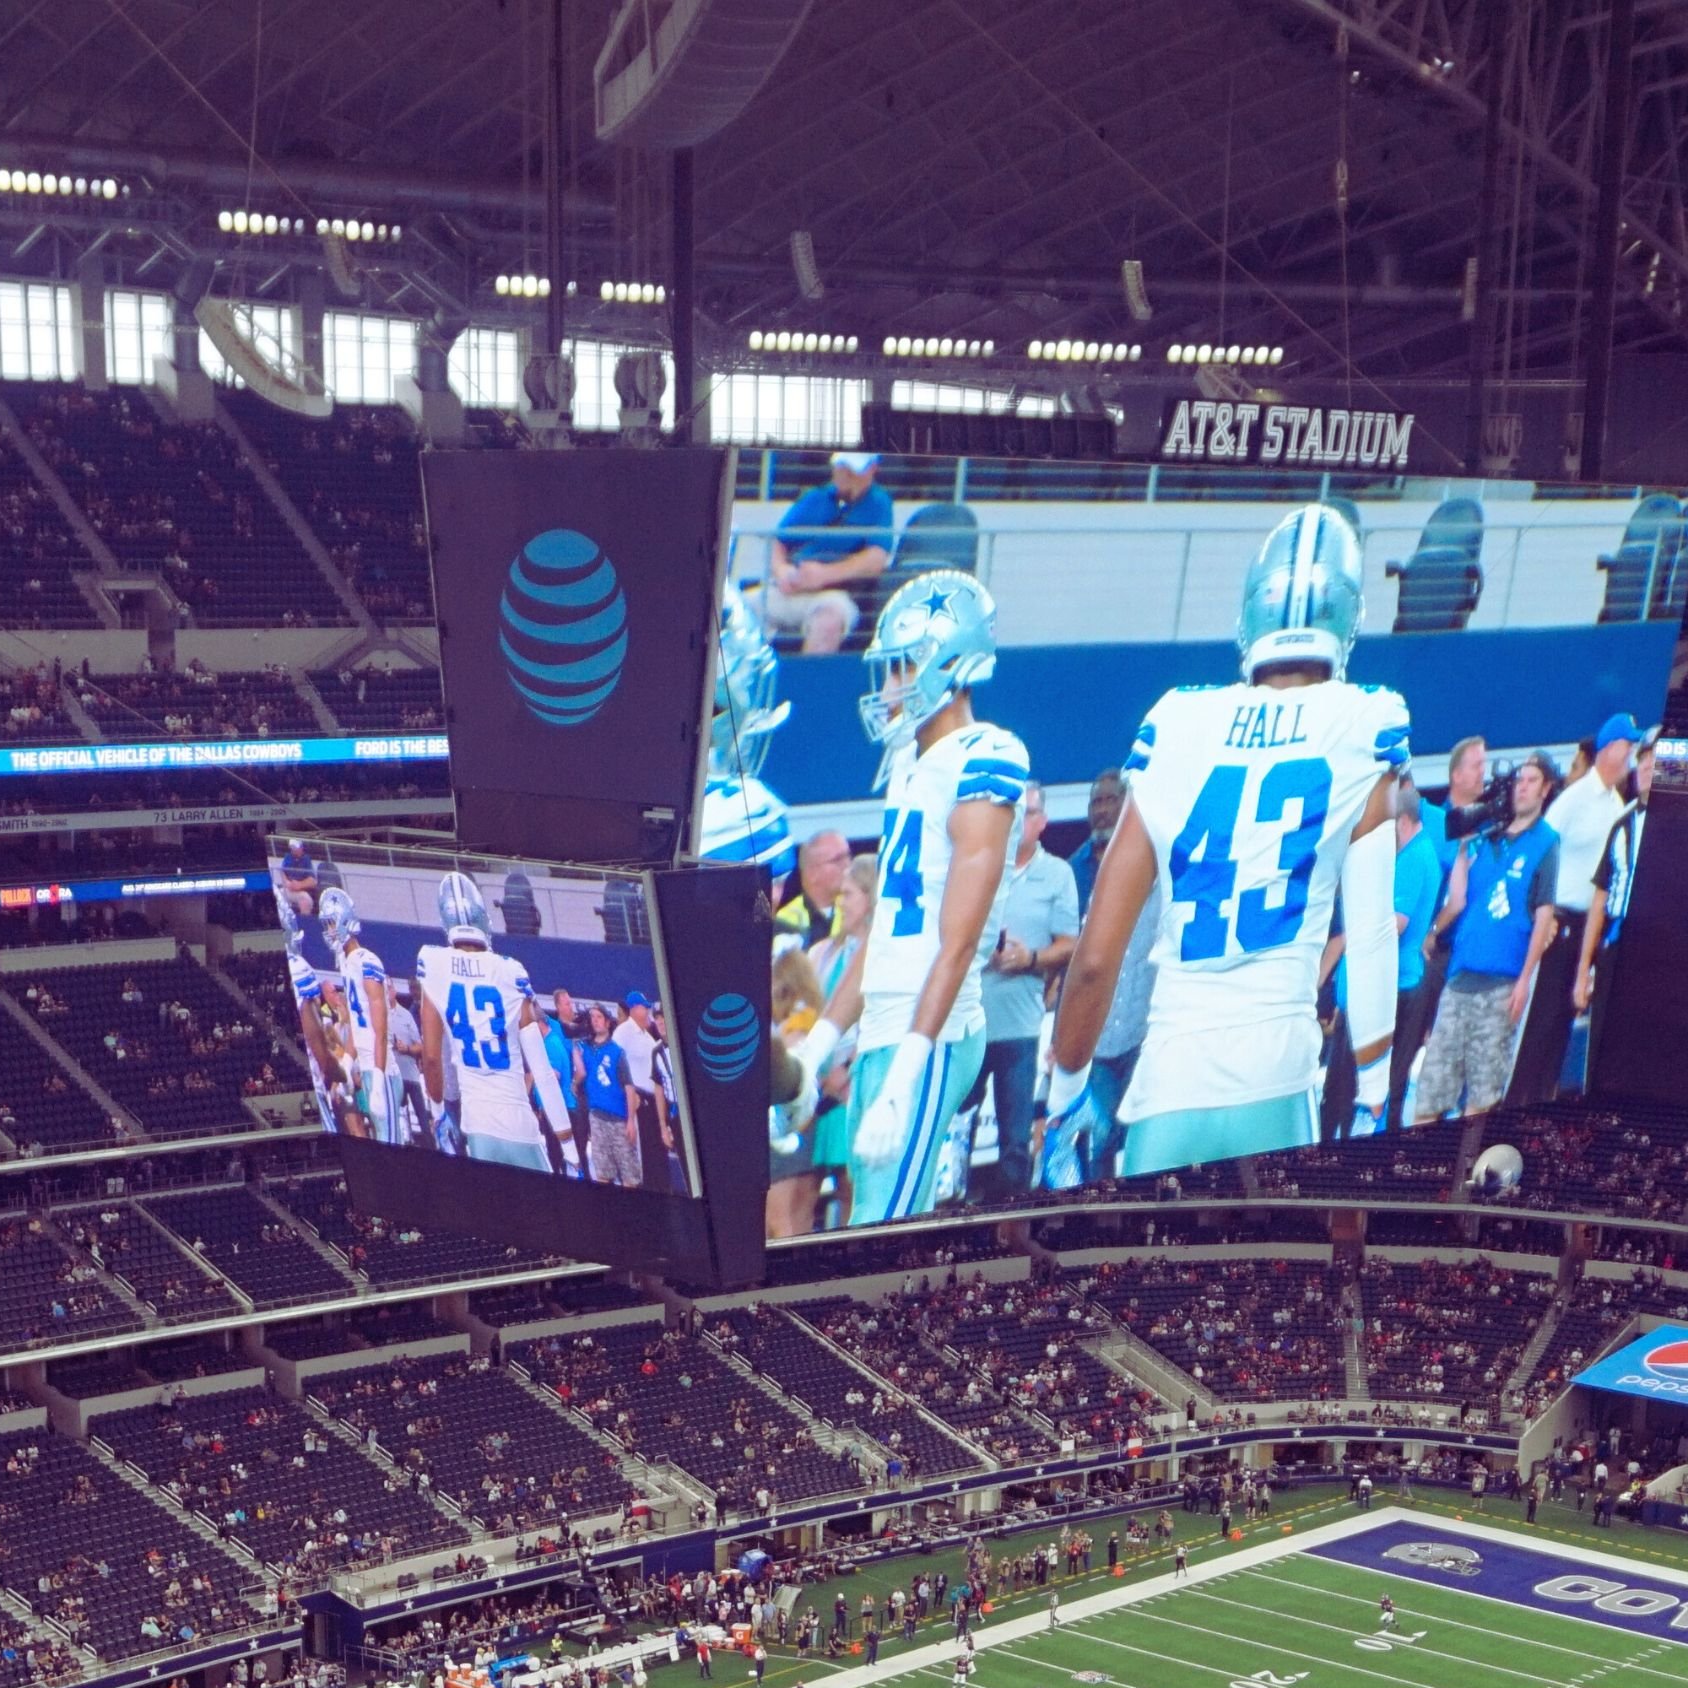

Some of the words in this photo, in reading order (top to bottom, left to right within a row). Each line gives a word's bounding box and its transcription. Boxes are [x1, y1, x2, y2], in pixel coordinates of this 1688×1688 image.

[1164, 400, 1260, 458] AT&T
[1261, 405, 1414, 465] STADIUM
[1224, 699, 1308, 747] HALL
[11, 752, 38, 771] THE
[39, 749, 94, 770] OFFICIAL
[95, 748, 149, 768] VEHICLE
[150, 747, 166, 766] OF
[167, 745, 194, 765] THE
[195, 744, 242, 764] DALLAS
[243, 742, 303, 762] COWBOYS
[355, 740, 386, 757] FORD
[387, 740, 401, 756] IS
[403, 738, 427, 756] THE
[1673, 742, 1686, 755] IS
[153, 810, 168, 824] 73
[172, 809, 207, 823] LARRY
[208, 807, 244, 821] ALLEN
[1170, 756, 1335, 962] 43
[450, 956, 486, 979] HALL
[444, 981, 510, 1070] 43
